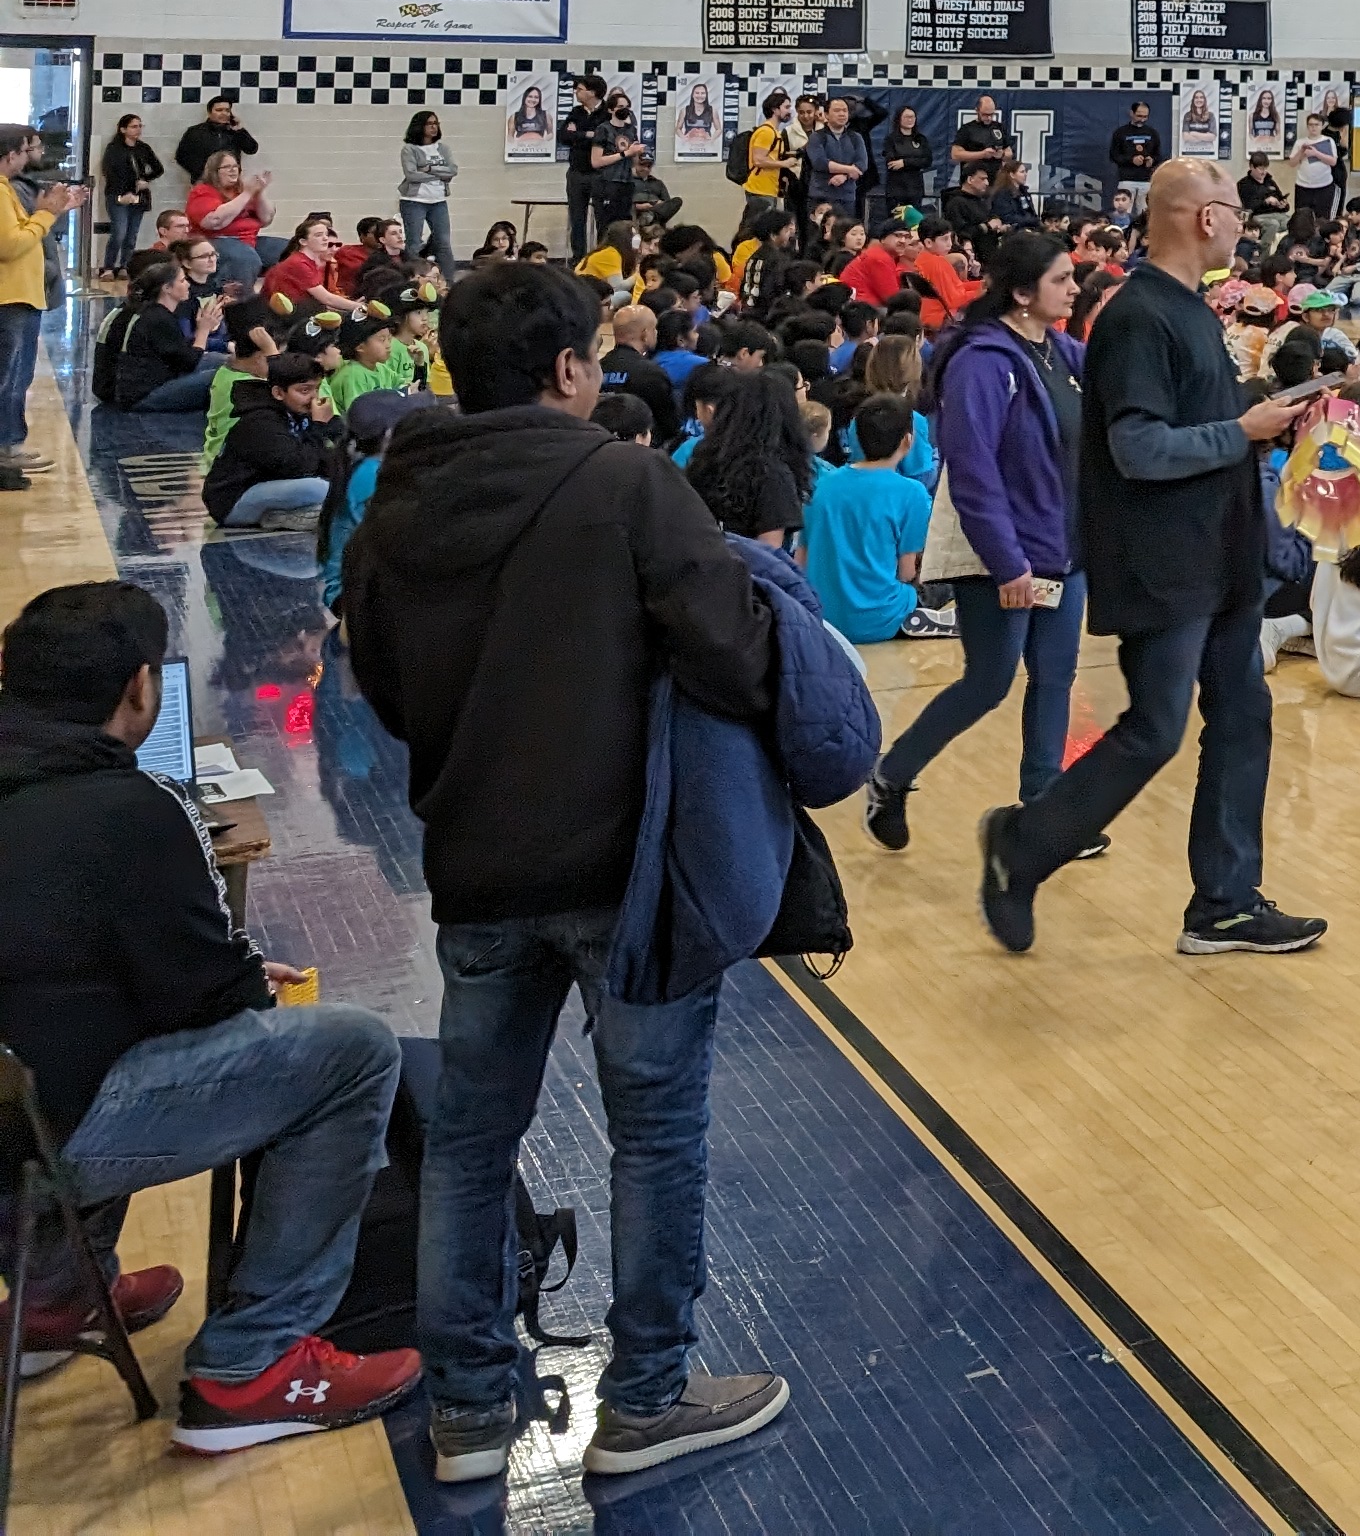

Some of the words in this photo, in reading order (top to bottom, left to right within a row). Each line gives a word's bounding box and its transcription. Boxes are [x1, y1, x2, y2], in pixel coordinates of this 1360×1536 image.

[376, 19, 416, 29] Respect
[422, 20, 439, 29] The
[444, 20, 473, 30] Game
[1193, 49, 1233, 60] OUTDOOR
[1237, 50, 1266, 61] TRACK
